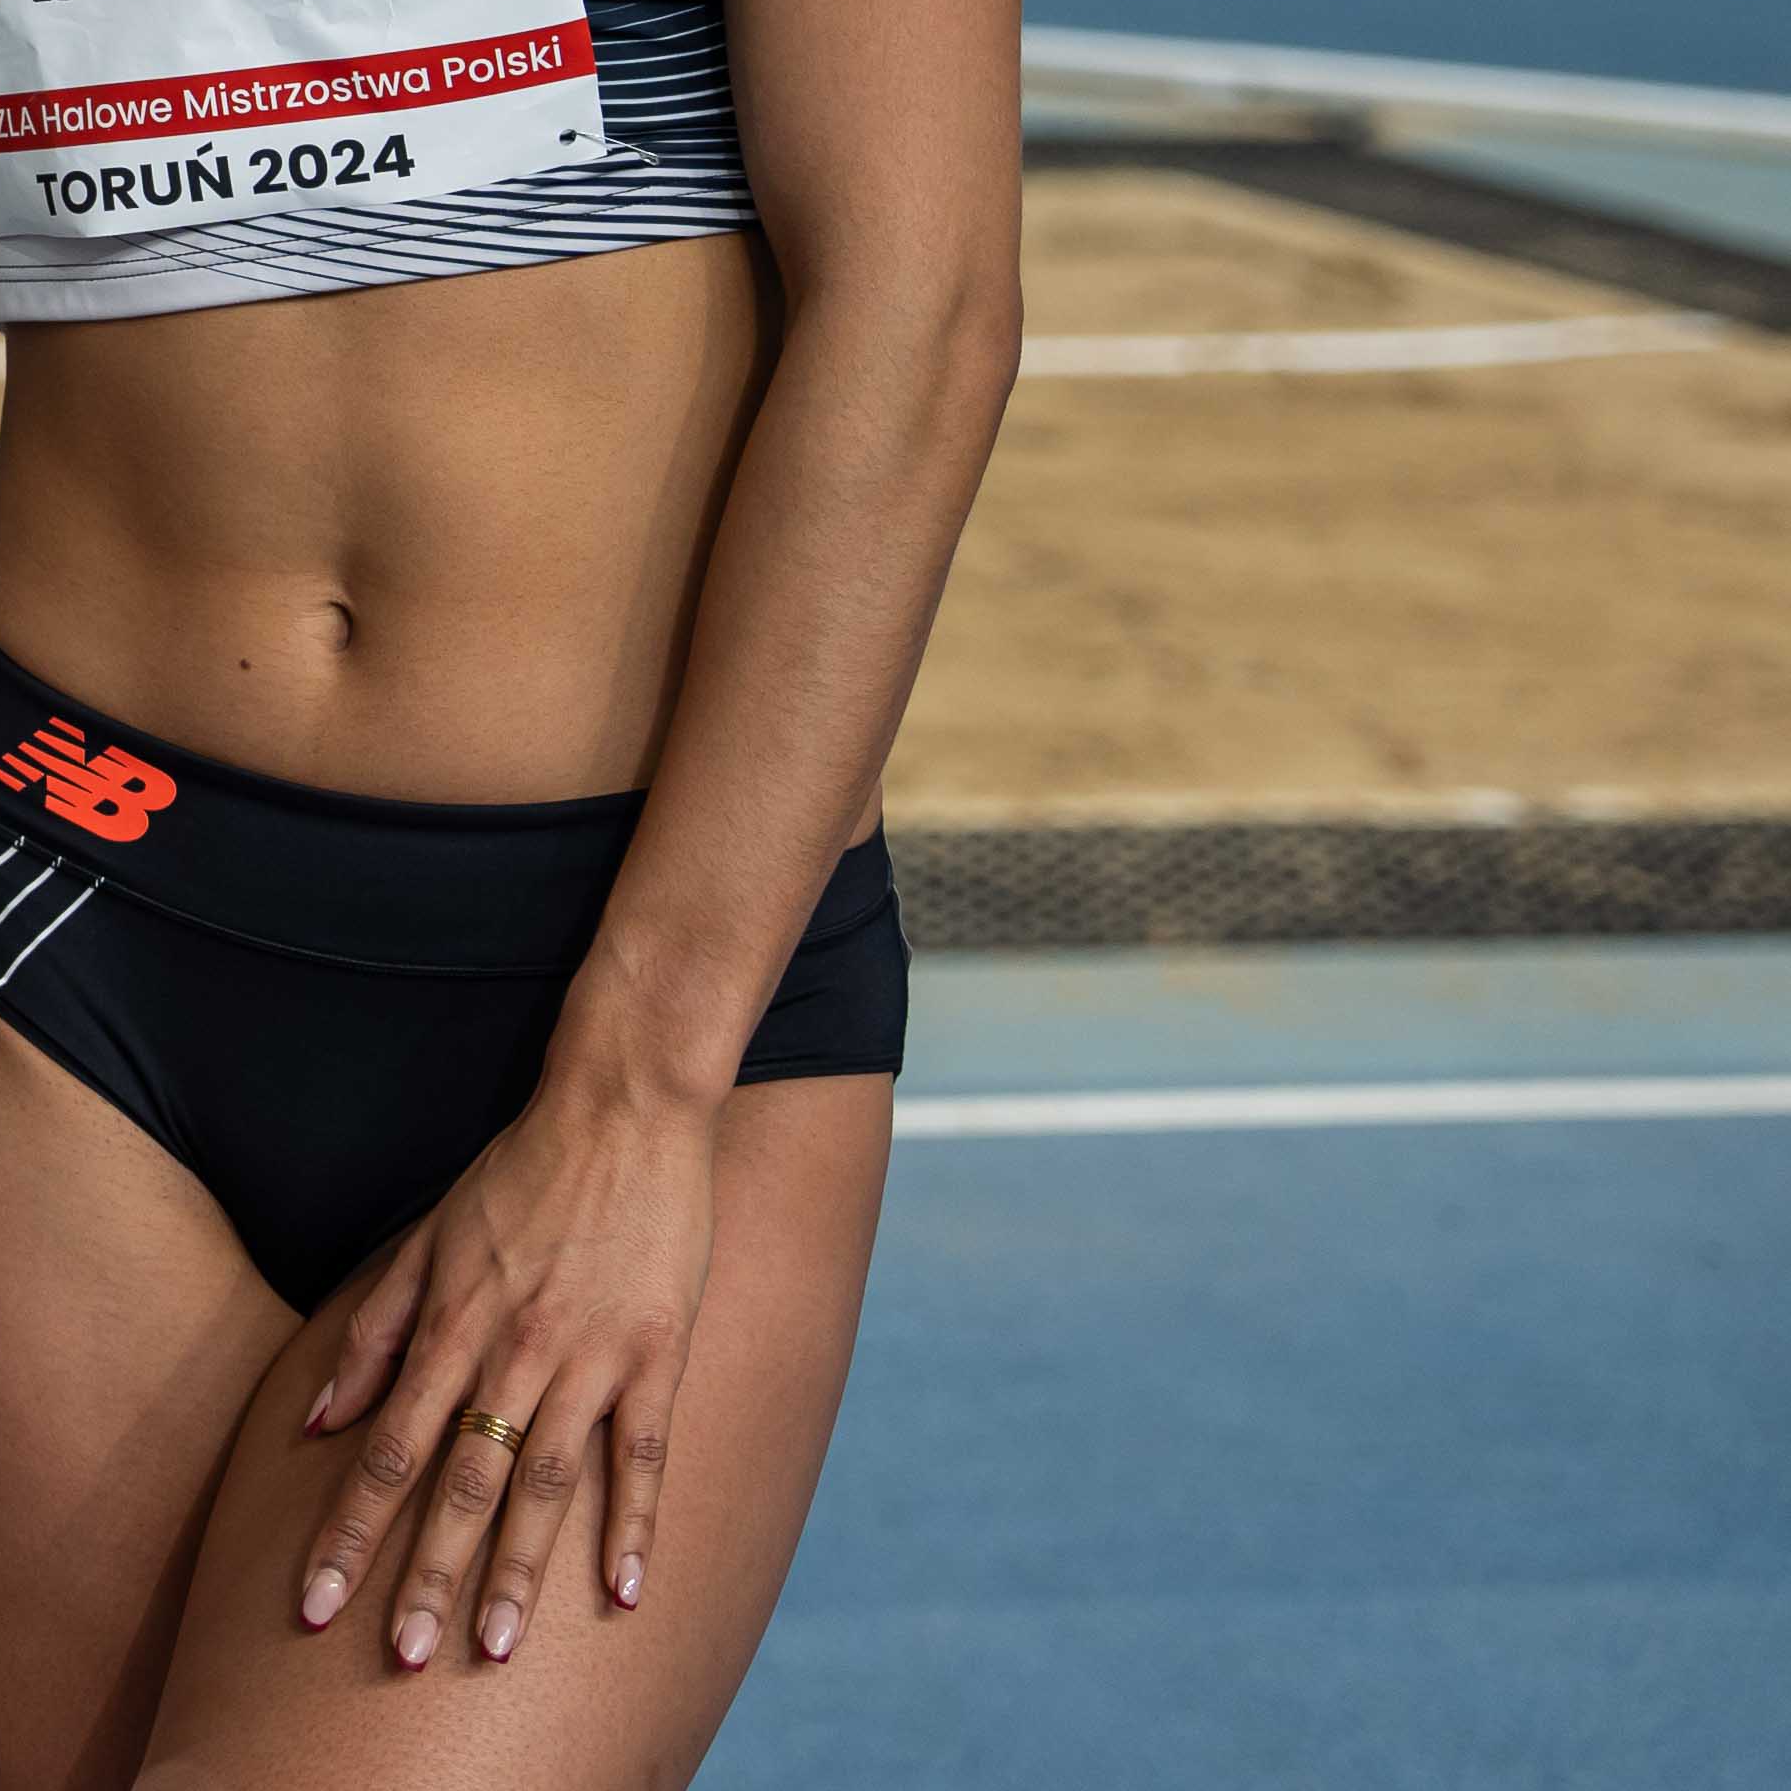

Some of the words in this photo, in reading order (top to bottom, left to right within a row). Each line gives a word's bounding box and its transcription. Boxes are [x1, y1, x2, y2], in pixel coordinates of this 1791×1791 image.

[42, 98, 172, 134] Halowe
[183, 69, 430, 120] Mistrzostwa
[442, 36, 563, 89] Polski
[36, 141, 231, 217] TORUŃ
[248, 134, 416, 195] 2024
